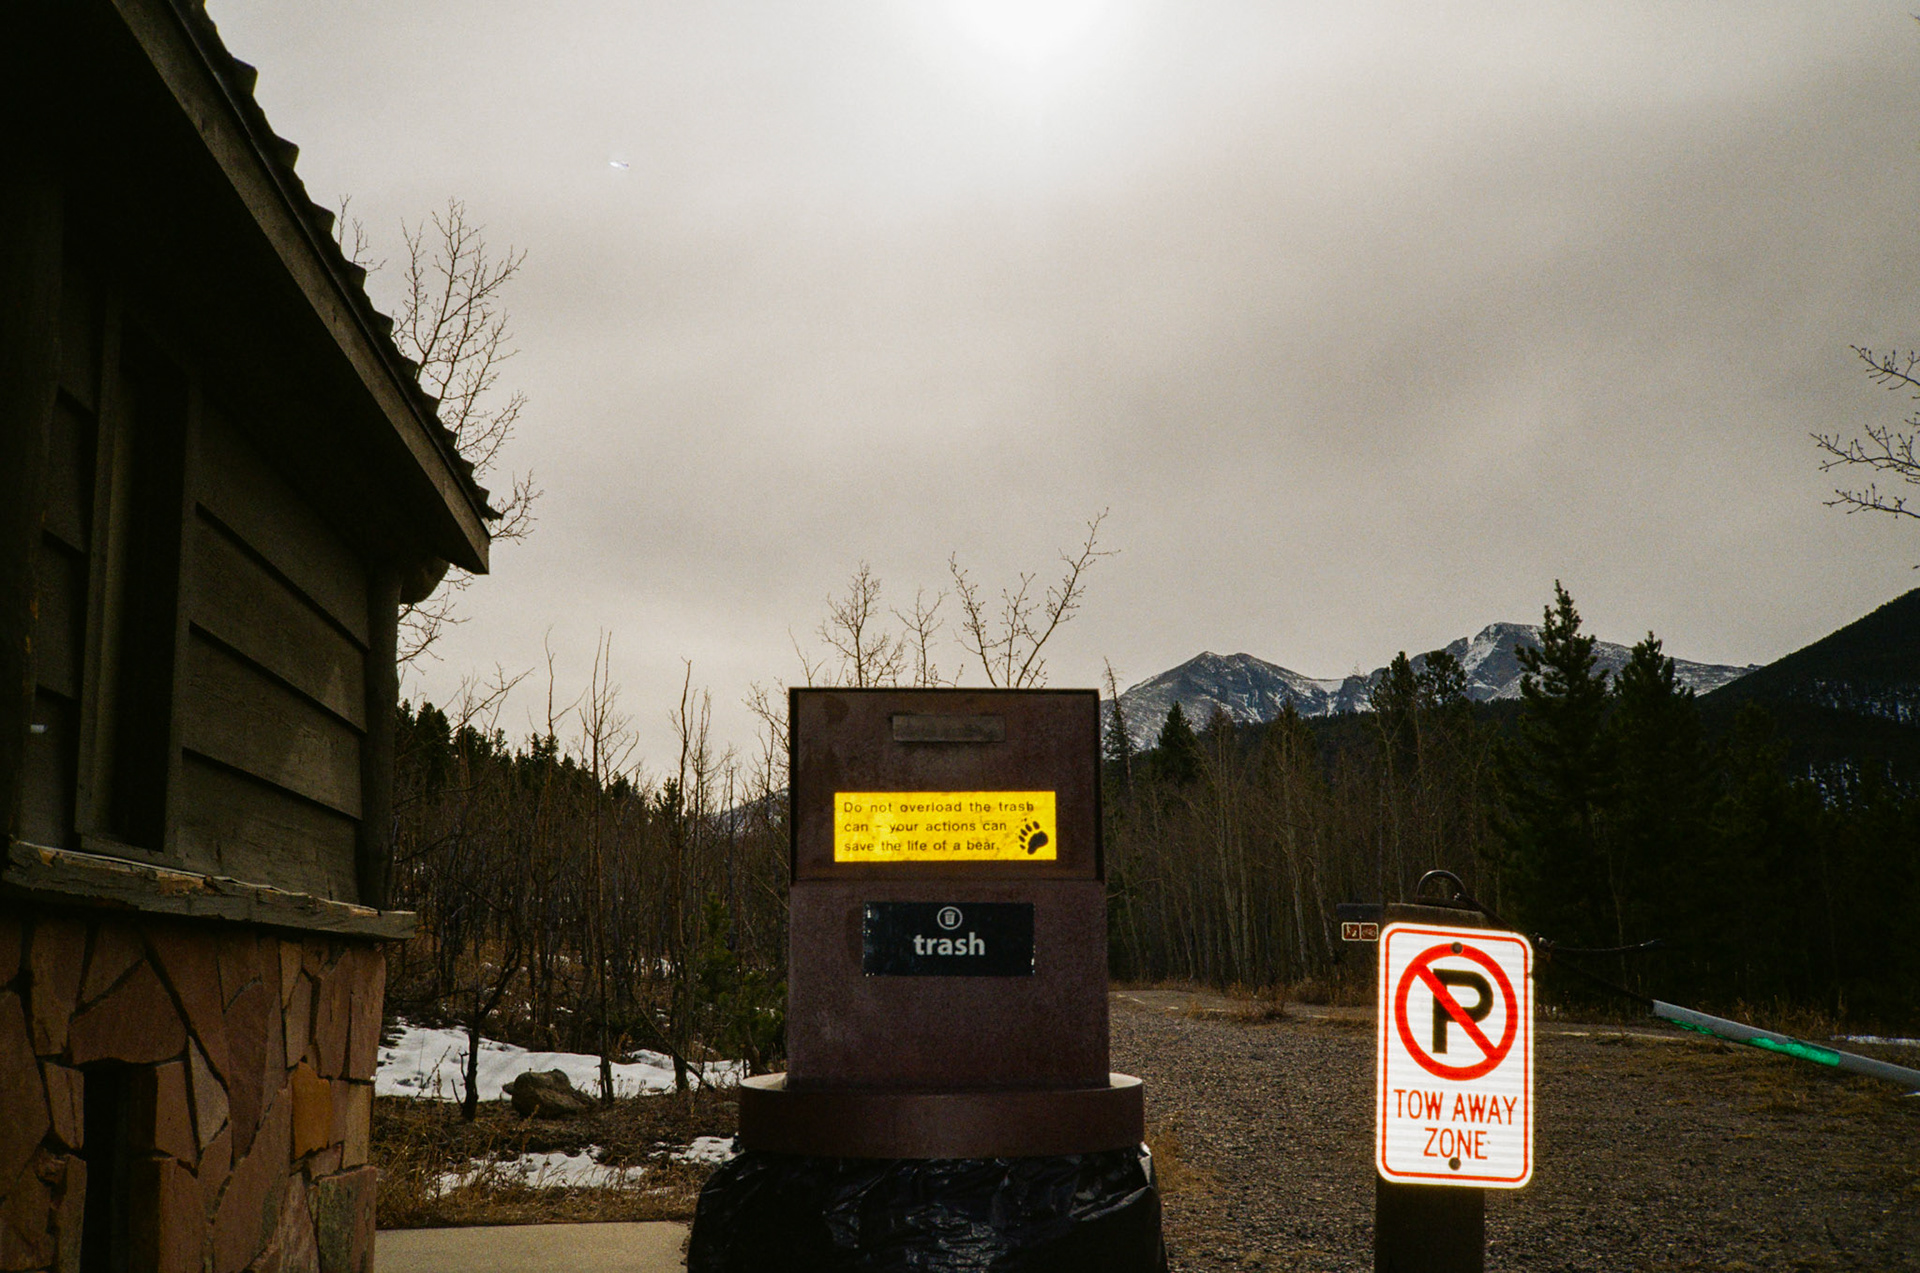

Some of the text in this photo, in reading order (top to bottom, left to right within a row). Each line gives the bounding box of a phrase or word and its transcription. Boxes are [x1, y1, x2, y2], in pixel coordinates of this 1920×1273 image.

[844, 801, 1034, 813] Do not overload the trash
[844, 823, 869, 832] can
[889, 823, 918, 834] your
[925, 821, 976, 832] actions
[982, 822, 1007, 831] can
[844, 840, 1000, 852] save the life of a bear.
[913, 931, 986, 956] trash
[1432, 968, 1494, 1054] P
[1393, 1089, 1518, 1125] TOW AWAY
[1423, 1127, 1488, 1160] ZONE
